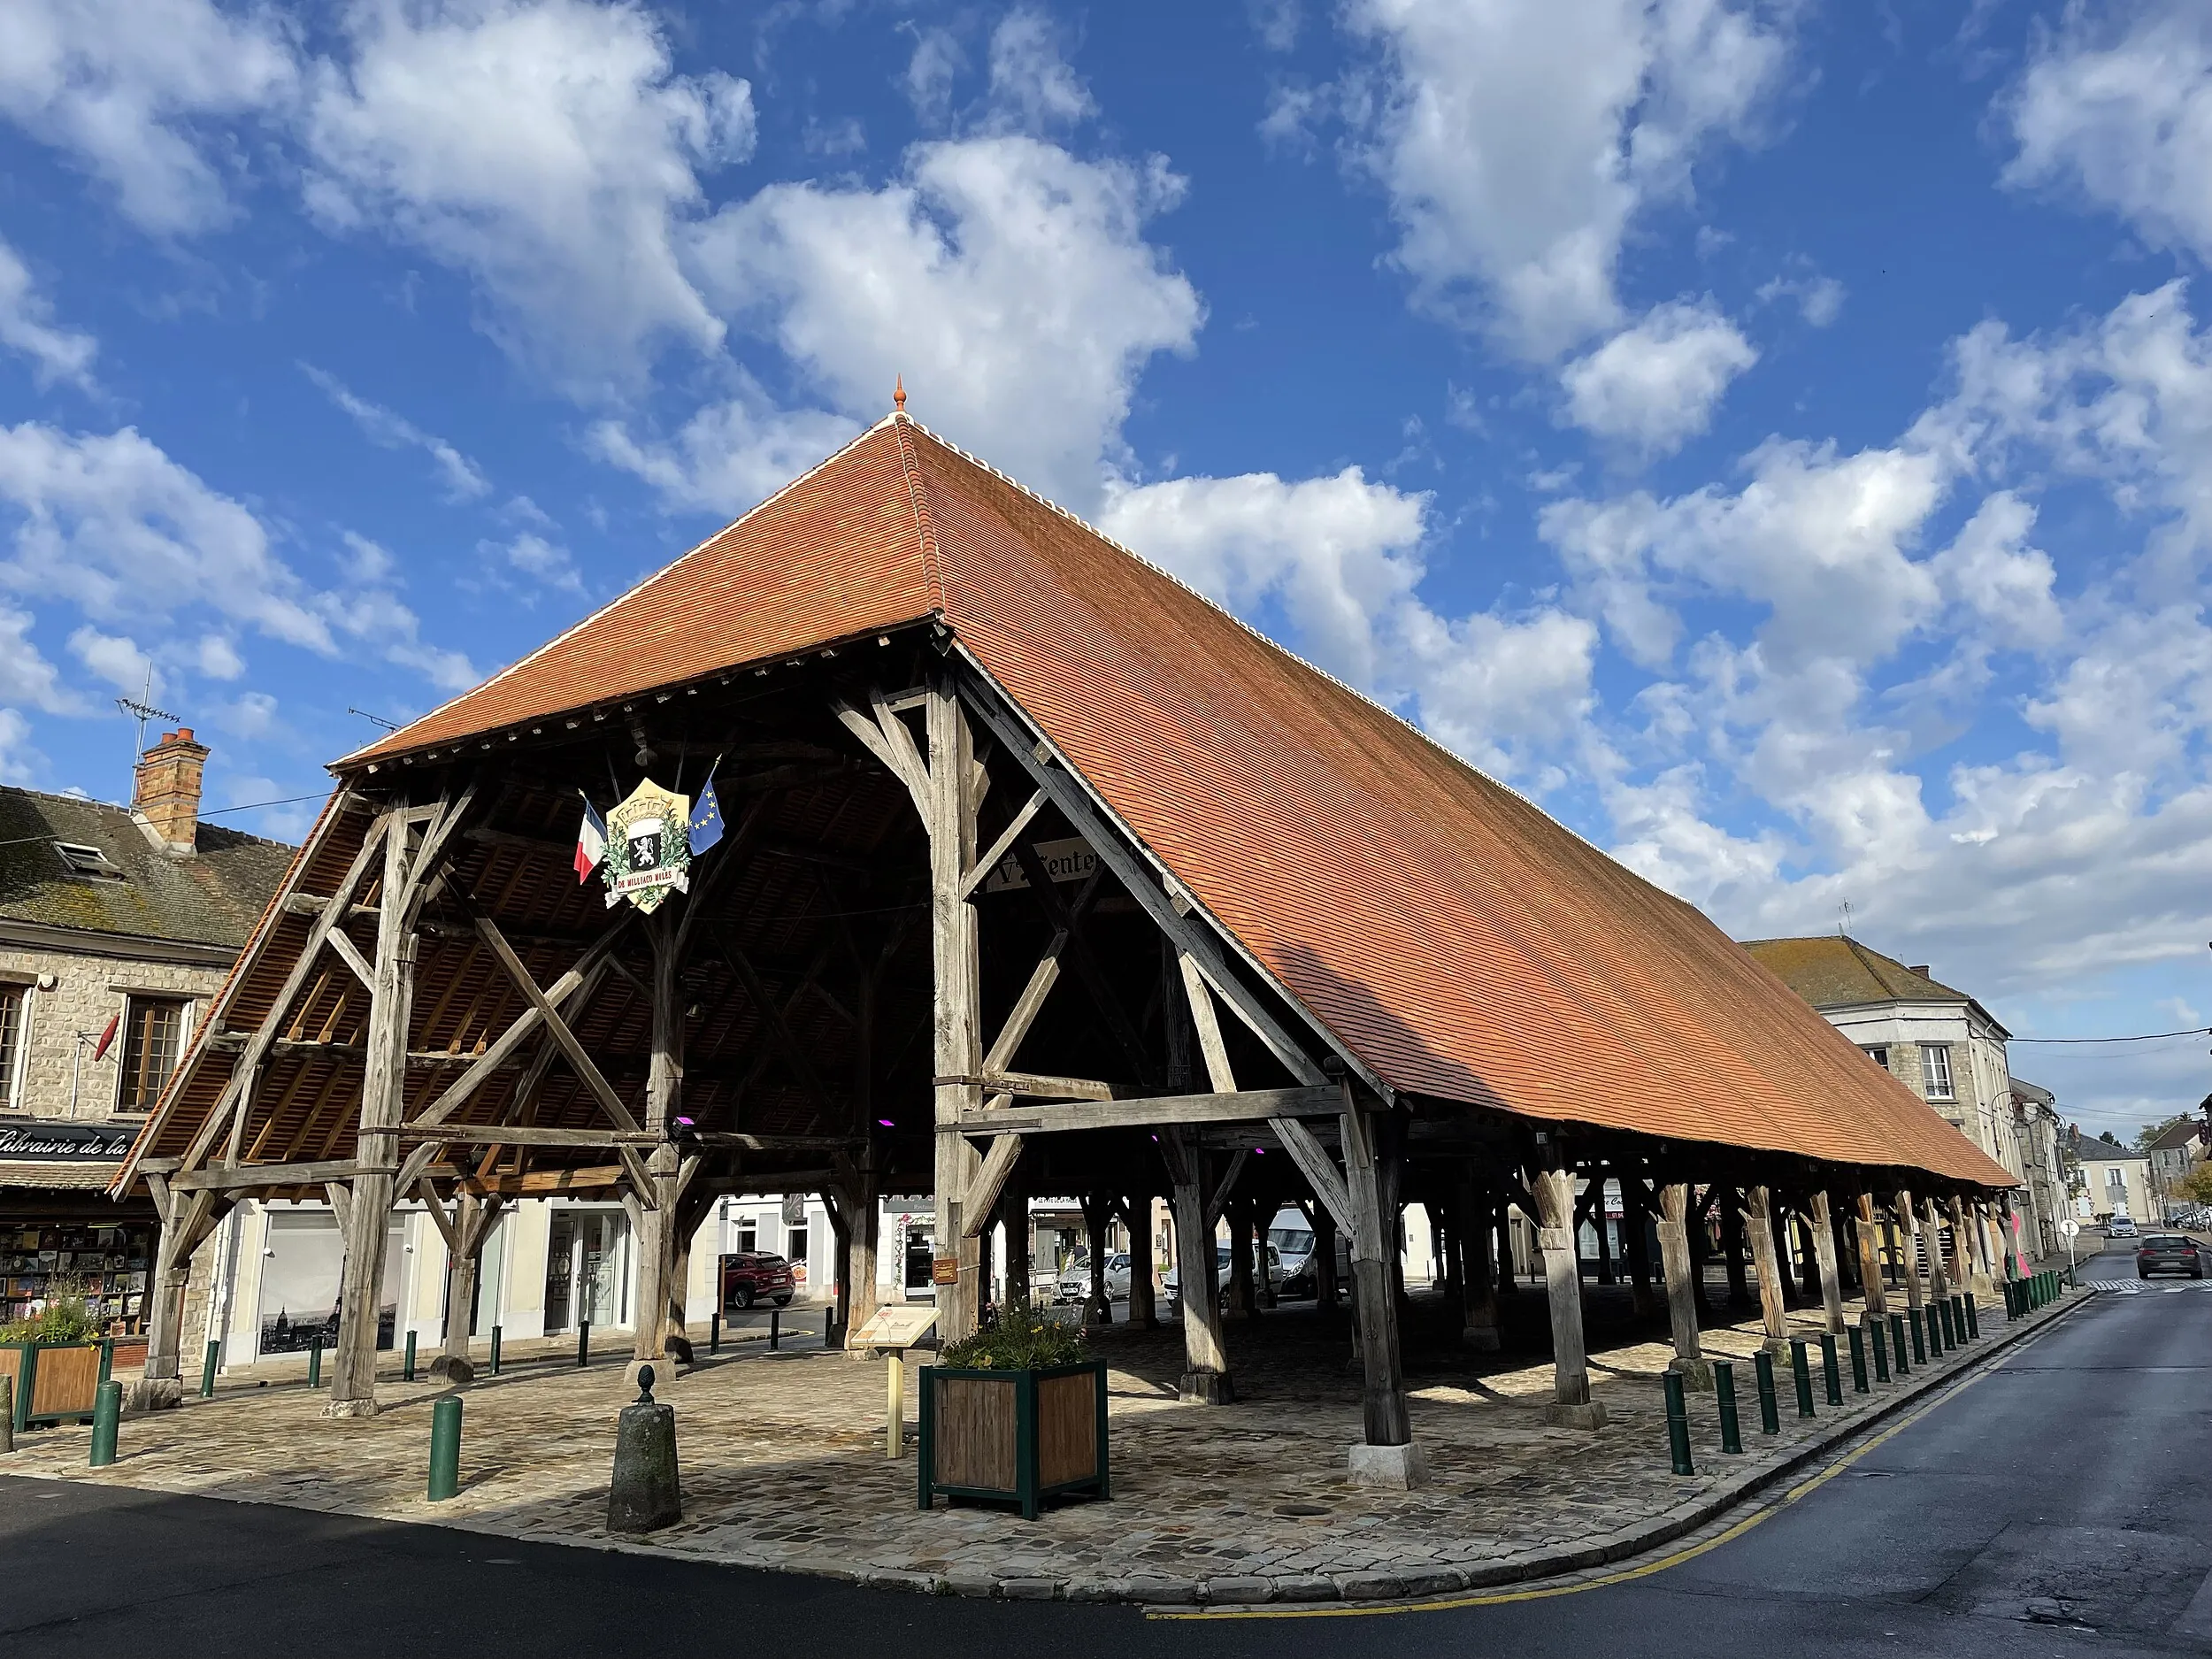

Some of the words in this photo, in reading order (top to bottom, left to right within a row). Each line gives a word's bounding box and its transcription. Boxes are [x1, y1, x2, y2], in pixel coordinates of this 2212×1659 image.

[618, 879, 625, 889] DE
[79, 1135, 104, 1155] de
[104, 1134, 127, 1155] la
